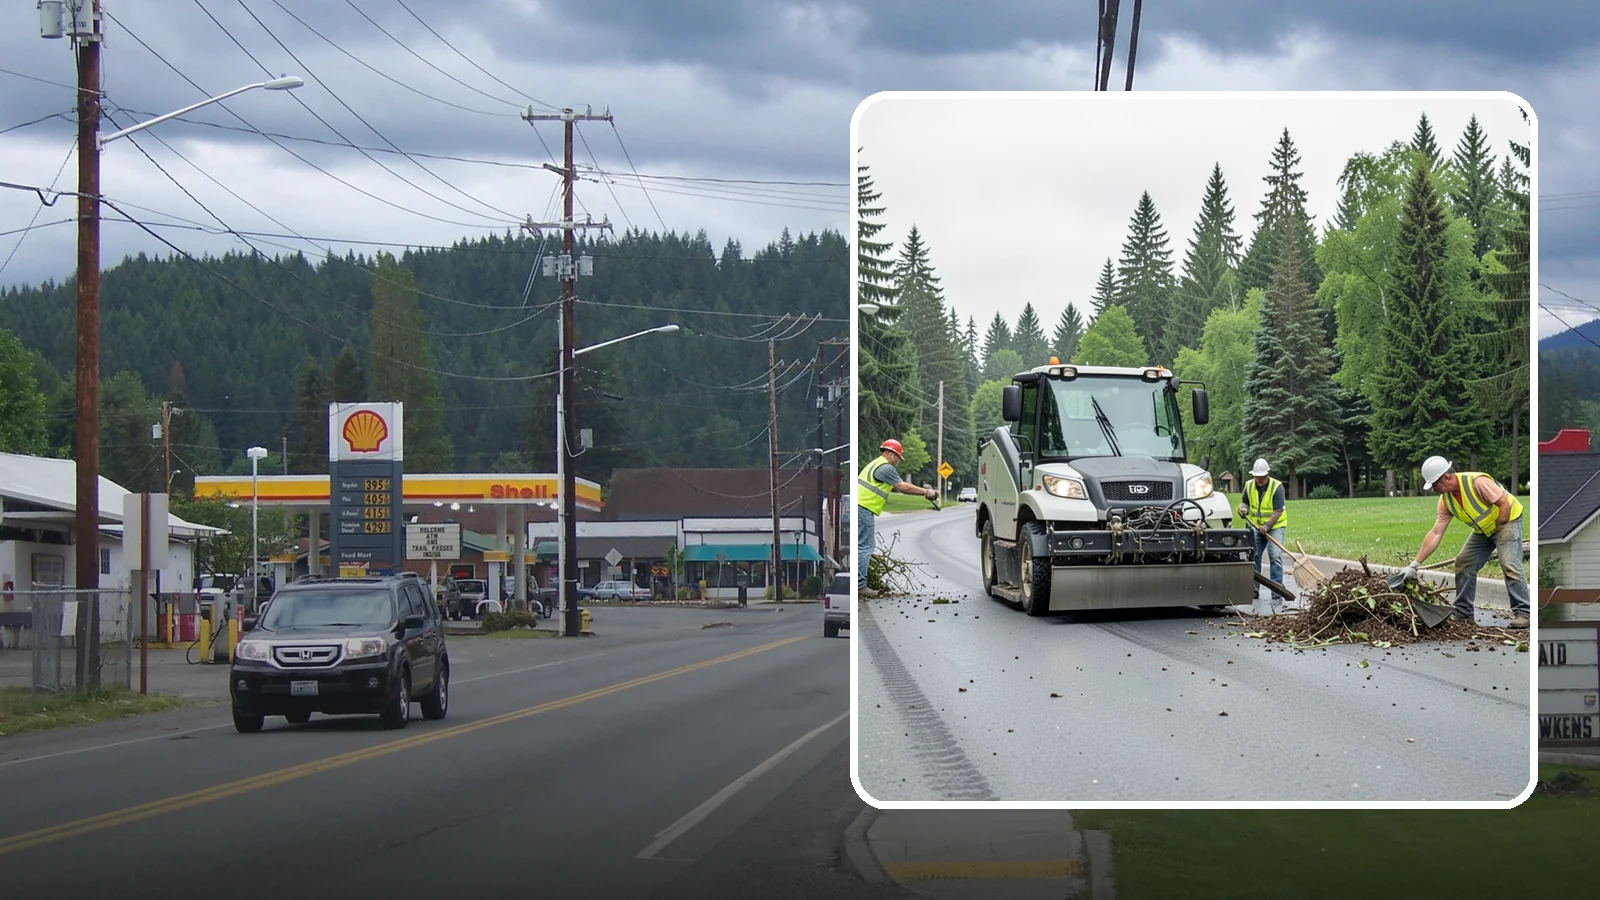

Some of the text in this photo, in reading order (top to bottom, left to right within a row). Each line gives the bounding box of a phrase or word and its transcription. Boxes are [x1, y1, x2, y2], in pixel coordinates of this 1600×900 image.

[365, 480, 384, 490] 395
[490, 484, 547, 499] Shell
[365, 494, 384, 504] 405
[365, 508, 384, 518] 415
[365, 522, 384, 533] 429
